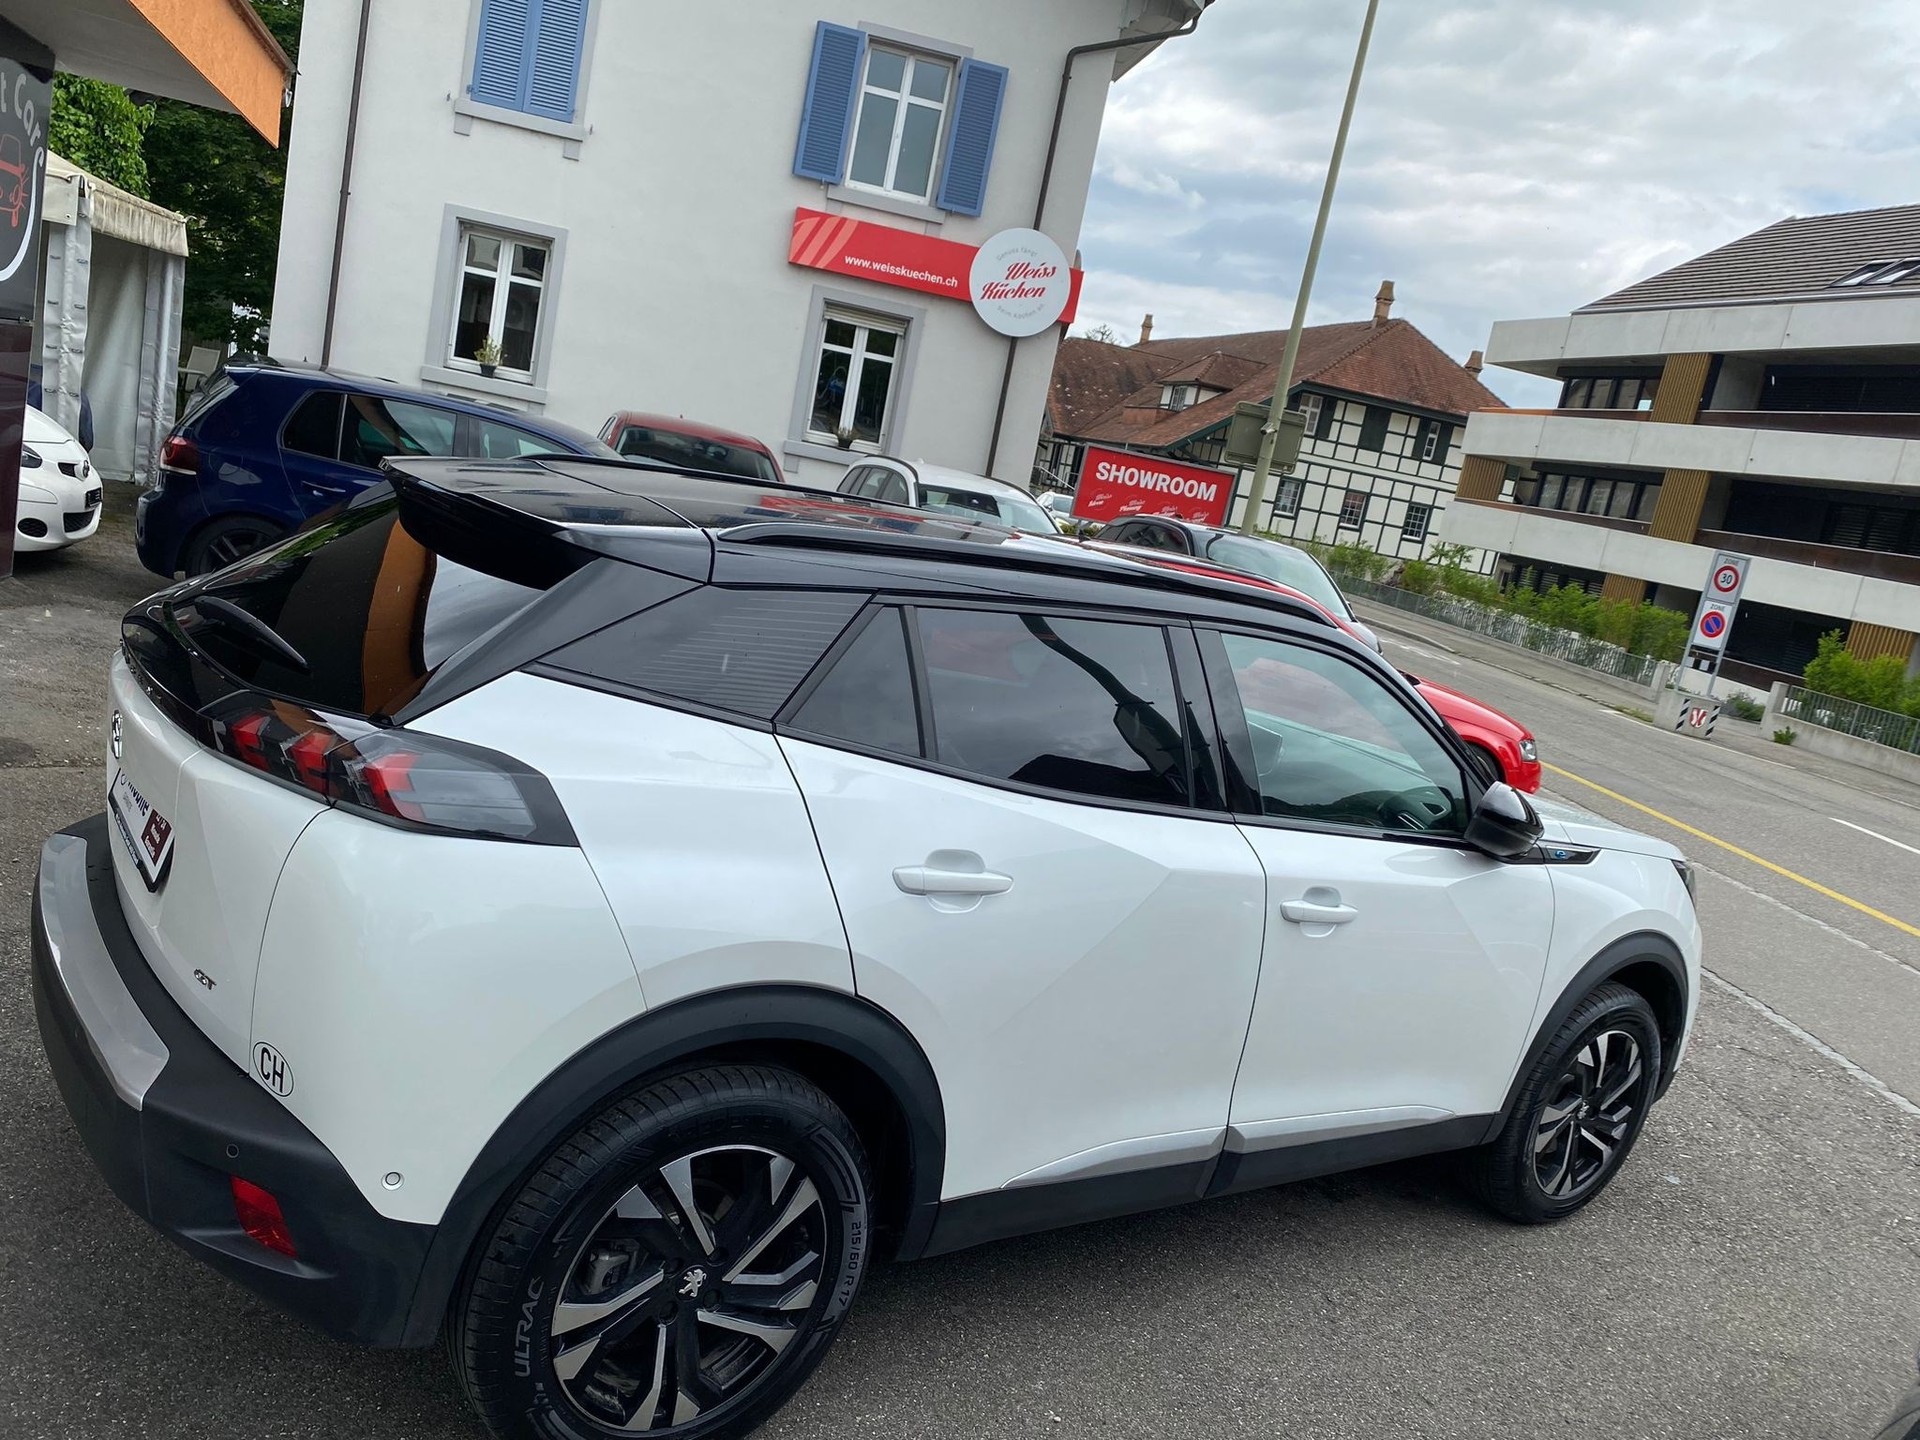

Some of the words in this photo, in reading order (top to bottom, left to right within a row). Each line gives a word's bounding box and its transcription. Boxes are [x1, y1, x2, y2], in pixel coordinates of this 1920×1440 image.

[845, 256, 958, 287] www.weisskuechen.ch
[1005, 262, 1057, 280] Weiss
[980, 281, 1046, 301] Küchen
[1096, 462, 1217, 501] SHOWROOM
[1720, 573, 1733, 584] 30
[193, 968, 217, 991] GT
[260, 1046, 286, 1094] CH
[848, 1221, 862, 1270] 215/60
[514, 1275, 545, 1378] ULTRAC
